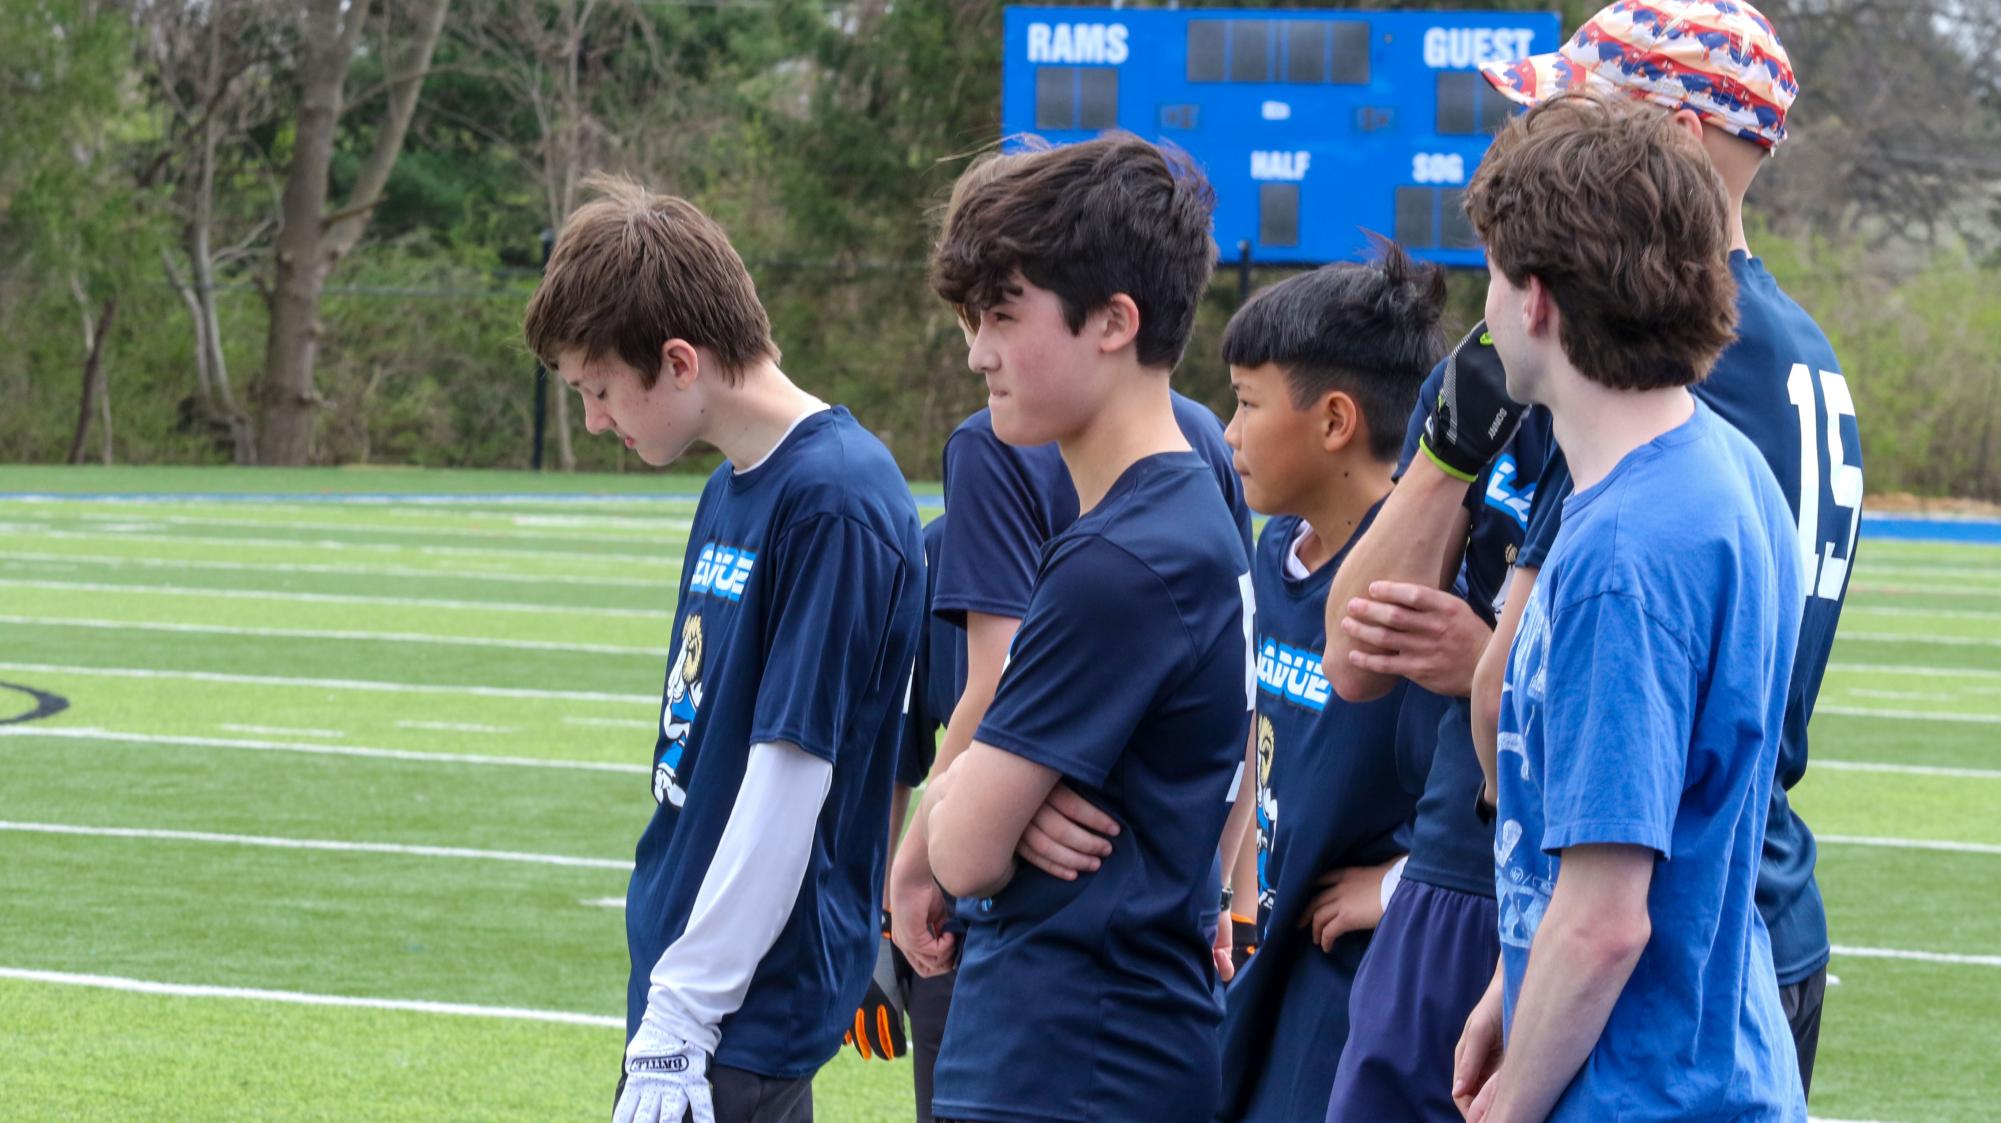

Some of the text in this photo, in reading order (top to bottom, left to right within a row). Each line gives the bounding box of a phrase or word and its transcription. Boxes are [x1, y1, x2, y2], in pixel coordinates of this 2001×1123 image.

[1027, 22, 1129, 64] RAMS
[1423, 27, 1535, 68] GUEST
[1250, 150, 1310, 180] HALF
[1787, 363, 1863, 601] 15
[1257, 640, 1331, 709] ADUE
